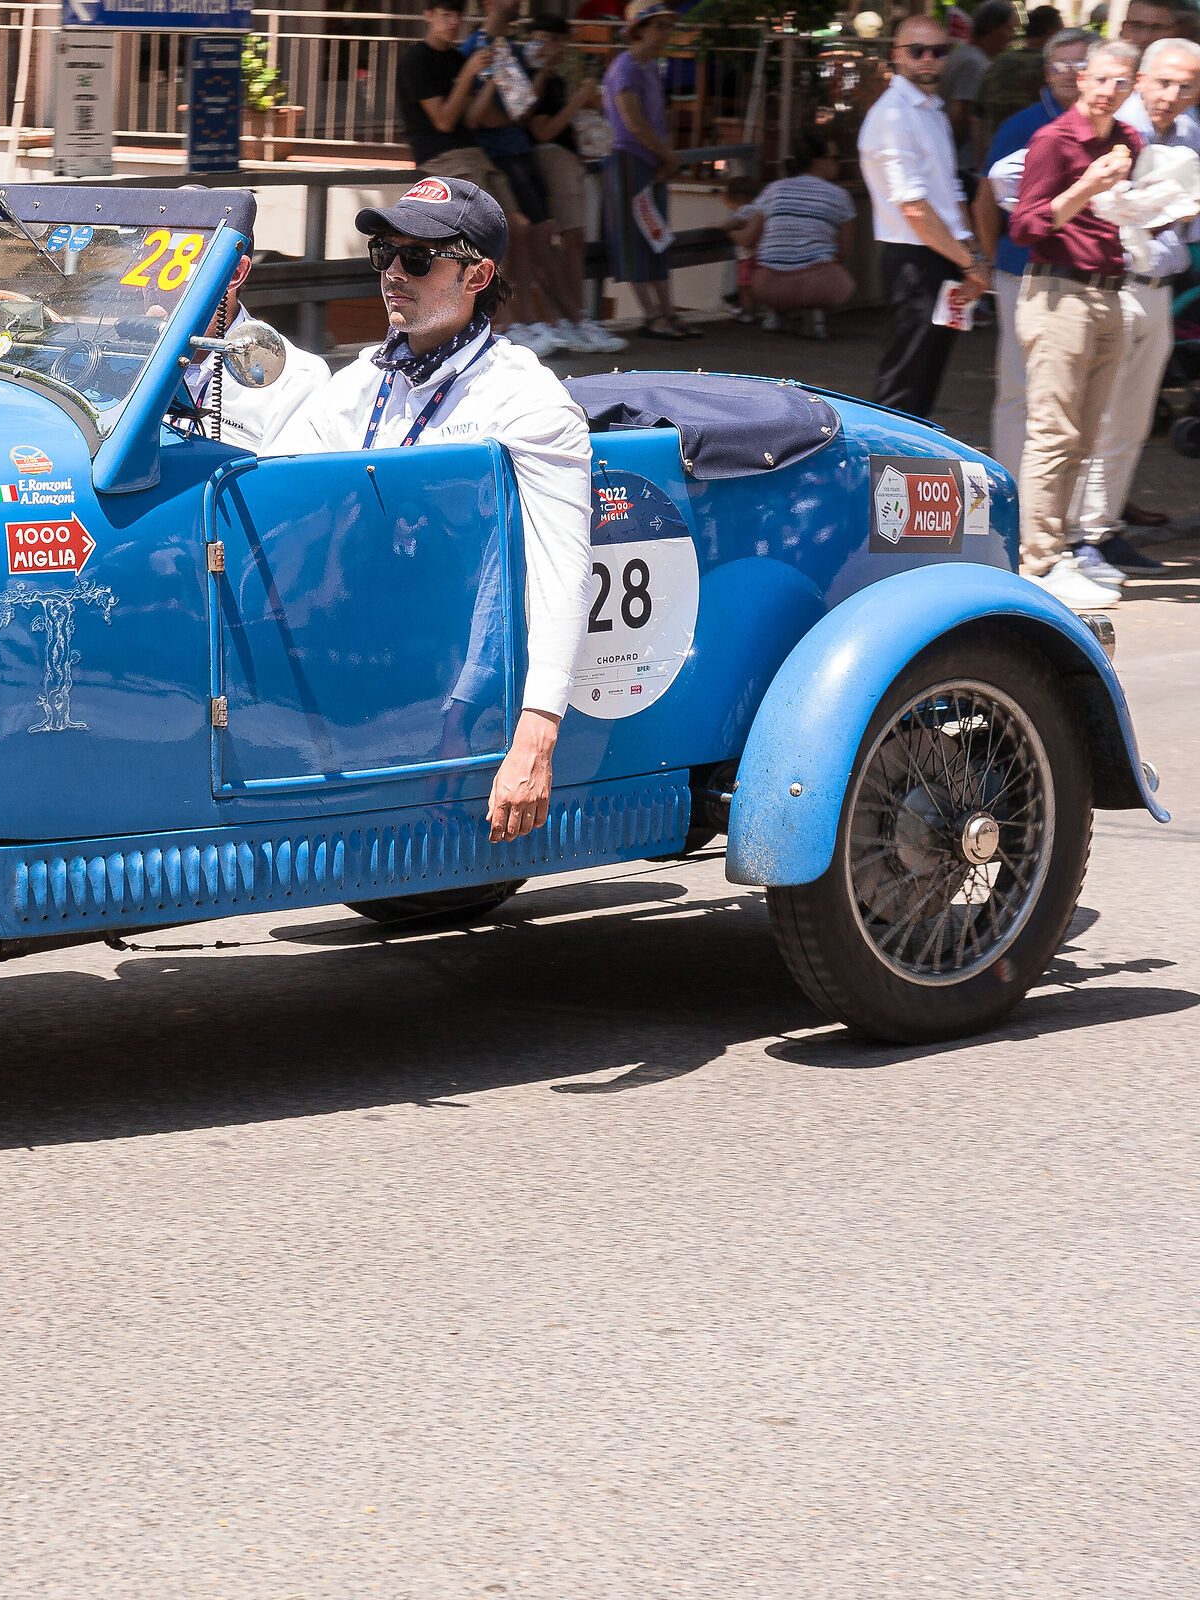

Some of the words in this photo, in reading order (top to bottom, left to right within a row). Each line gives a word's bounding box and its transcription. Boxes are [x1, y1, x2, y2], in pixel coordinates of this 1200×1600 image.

[404, 184, 445, 200] GATTI
[120, 230, 204, 291] 28
[18, 478, 72, 492] E.Ronzoni
[917, 481, 951, 502] 1000
[20, 491, 76, 506] A.Ronzoni
[599, 487, 628, 501] 2022
[600, 502, 628, 511] 1000
[600, 511, 629, 521] MIGLIA
[913, 510, 952, 531] MIGLIA
[15, 526, 70, 545] 1000
[13, 548, 76, 568] MIGLIA
[587, 558, 652, 633] 28
[596, 653, 639, 665] CHOPARD
